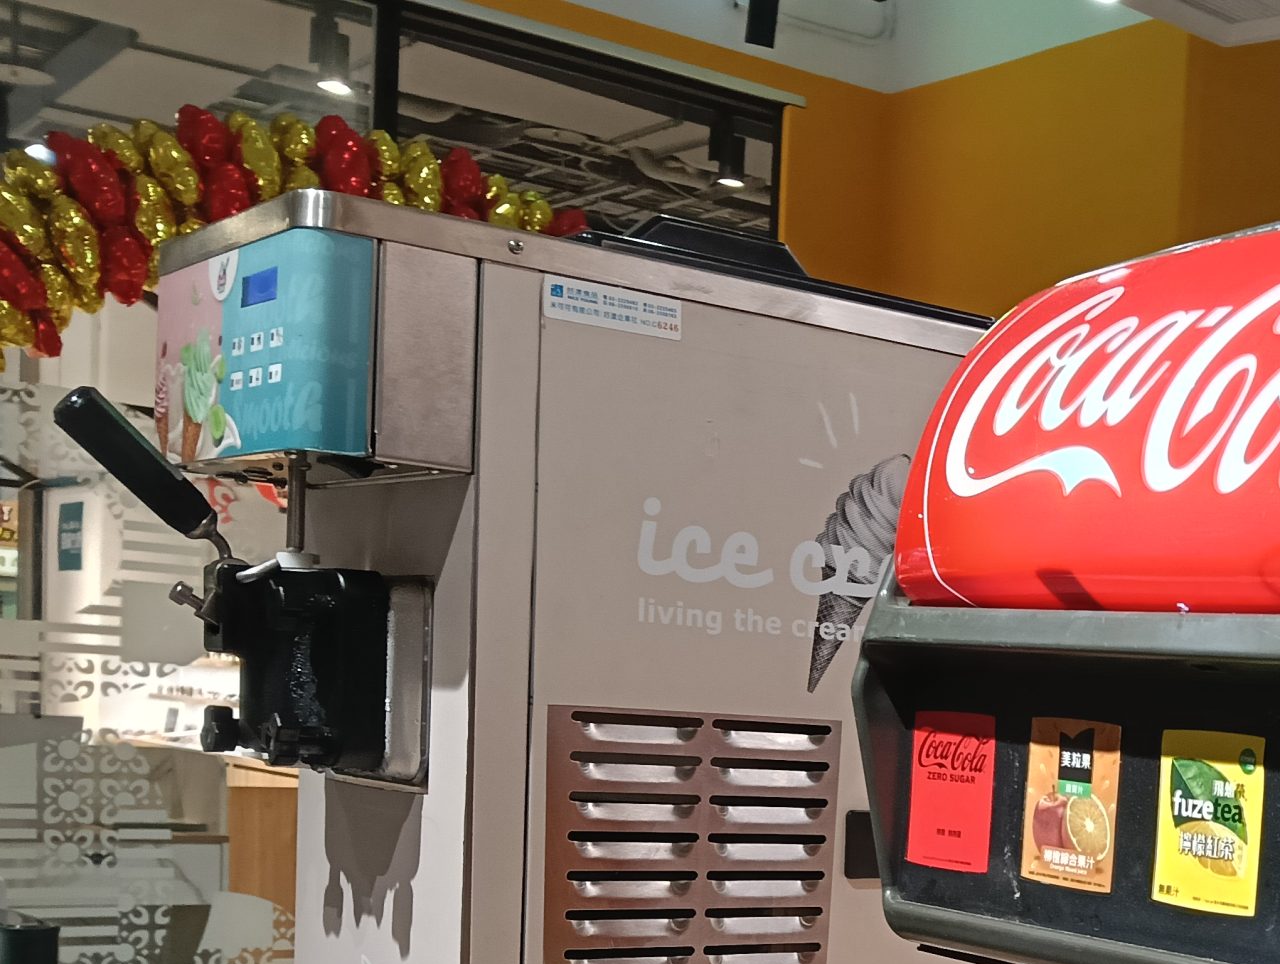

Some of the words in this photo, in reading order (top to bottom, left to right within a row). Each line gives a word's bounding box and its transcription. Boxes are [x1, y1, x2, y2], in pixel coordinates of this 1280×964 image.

[637, 496, 775, 590] ice
[789, 540, 896, 599] cr
[637, 598, 723, 635] living
[734, 609, 781, 635] the
[918, 727, 989, 773] Coca-Cola
[1060, 751, 1092, 769] 美粒果
[926, 771, 948, 783] ZERO
[949, 773, 976, 785] SUGAR
[1178, 831, 1236, 861] 檸檬紅茶
